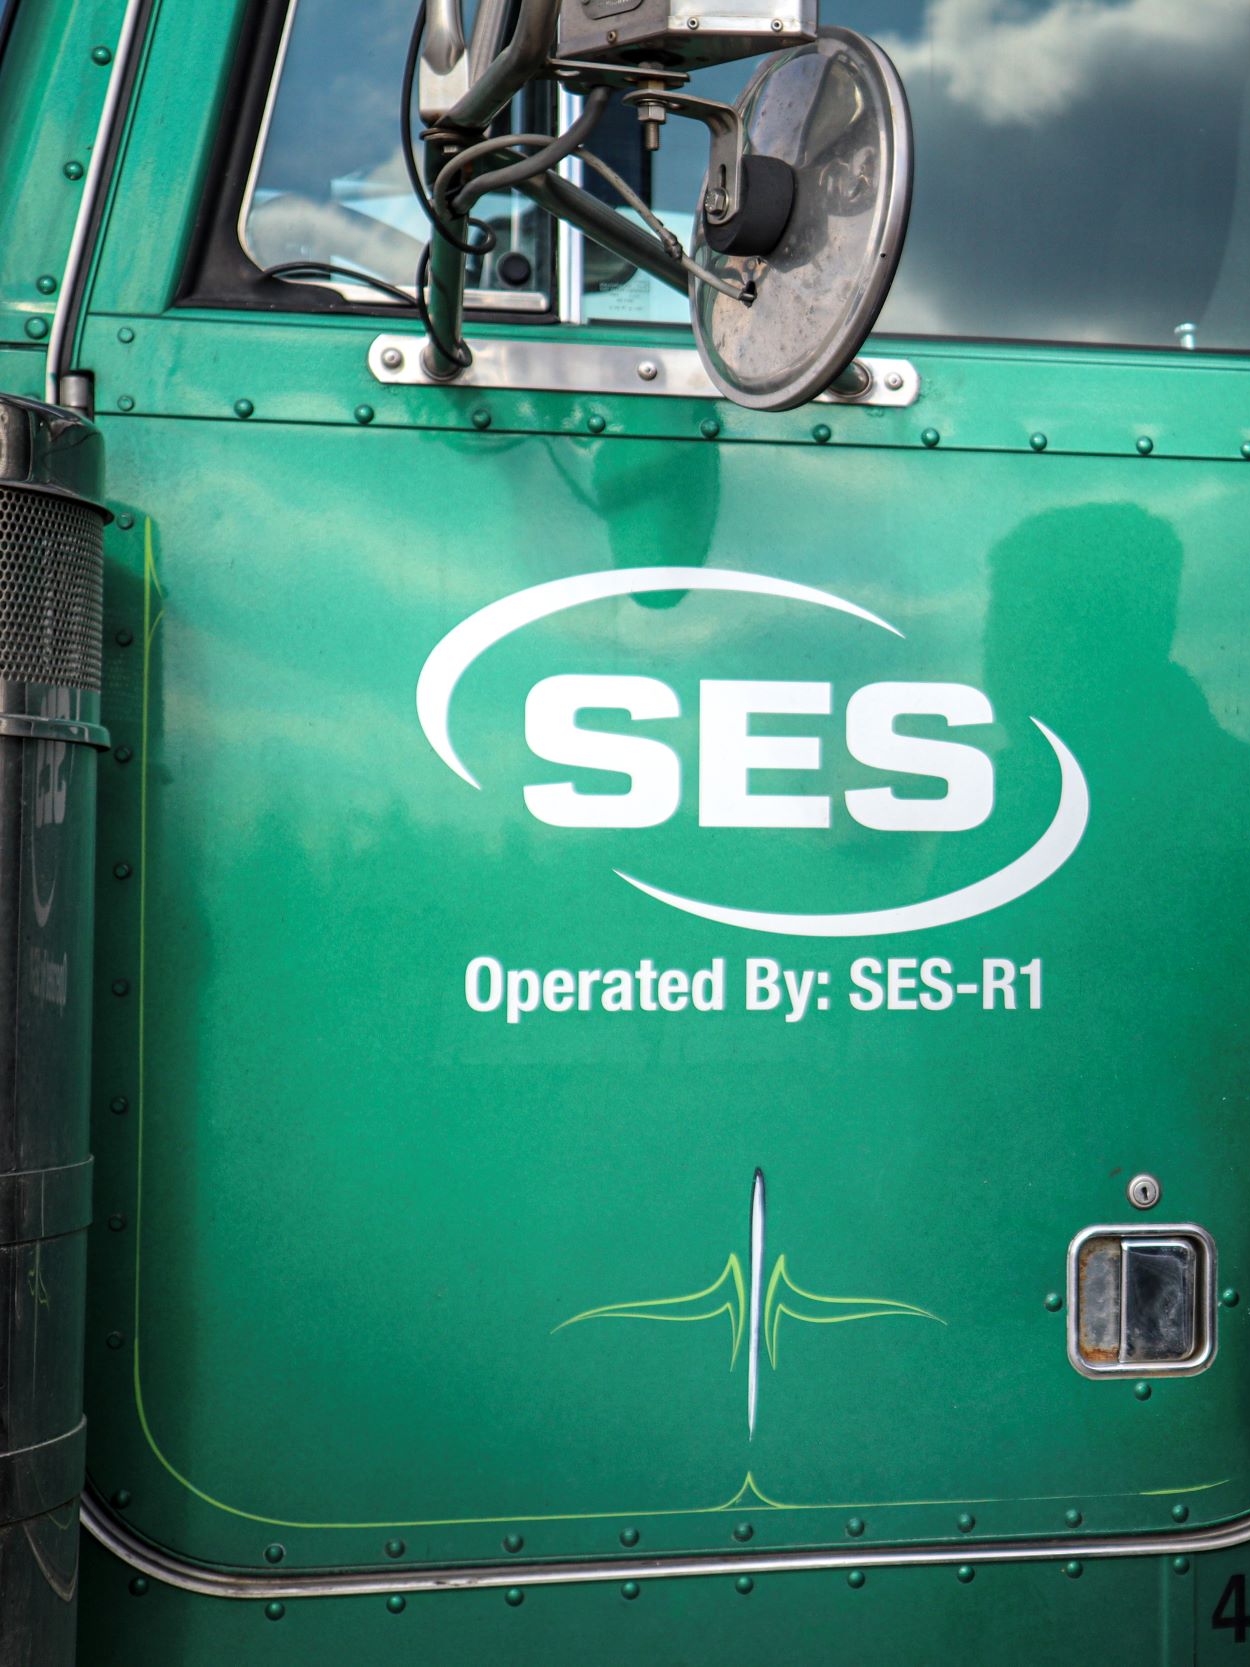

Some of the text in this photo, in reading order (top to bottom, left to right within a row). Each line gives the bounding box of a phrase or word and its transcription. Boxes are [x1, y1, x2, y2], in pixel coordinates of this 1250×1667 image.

[522, 673, 996, 832] SES
[464, 956, 1043, 1023] Operated By: SES-R1
